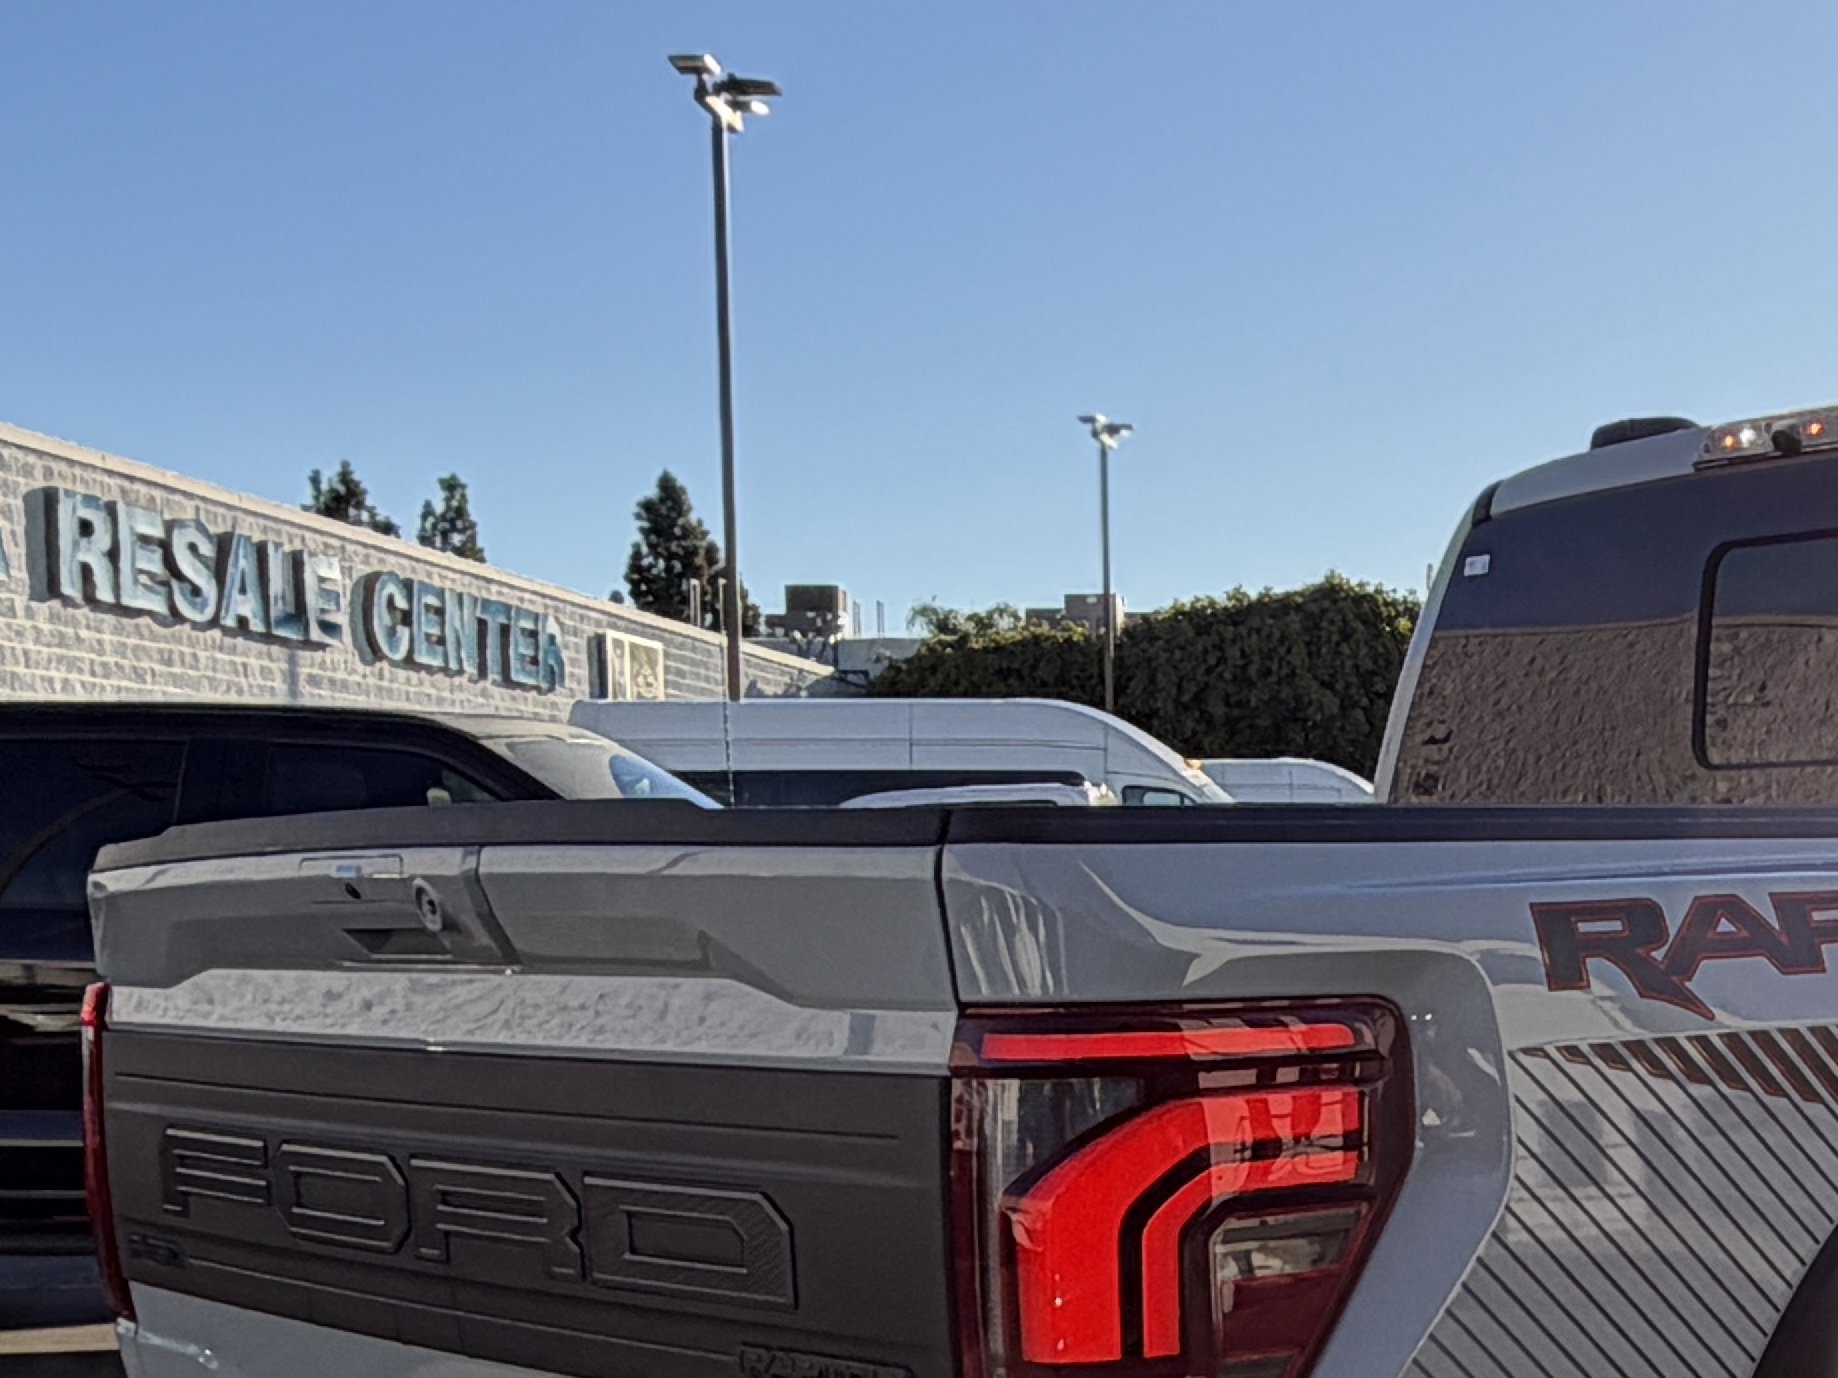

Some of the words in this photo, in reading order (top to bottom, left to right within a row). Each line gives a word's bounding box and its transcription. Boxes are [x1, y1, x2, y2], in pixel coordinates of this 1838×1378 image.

[50, 485, 345, 646] RESALE
[366, 569, 566, 692] CENTER
[162, 1125, 799, 1311] FORD
